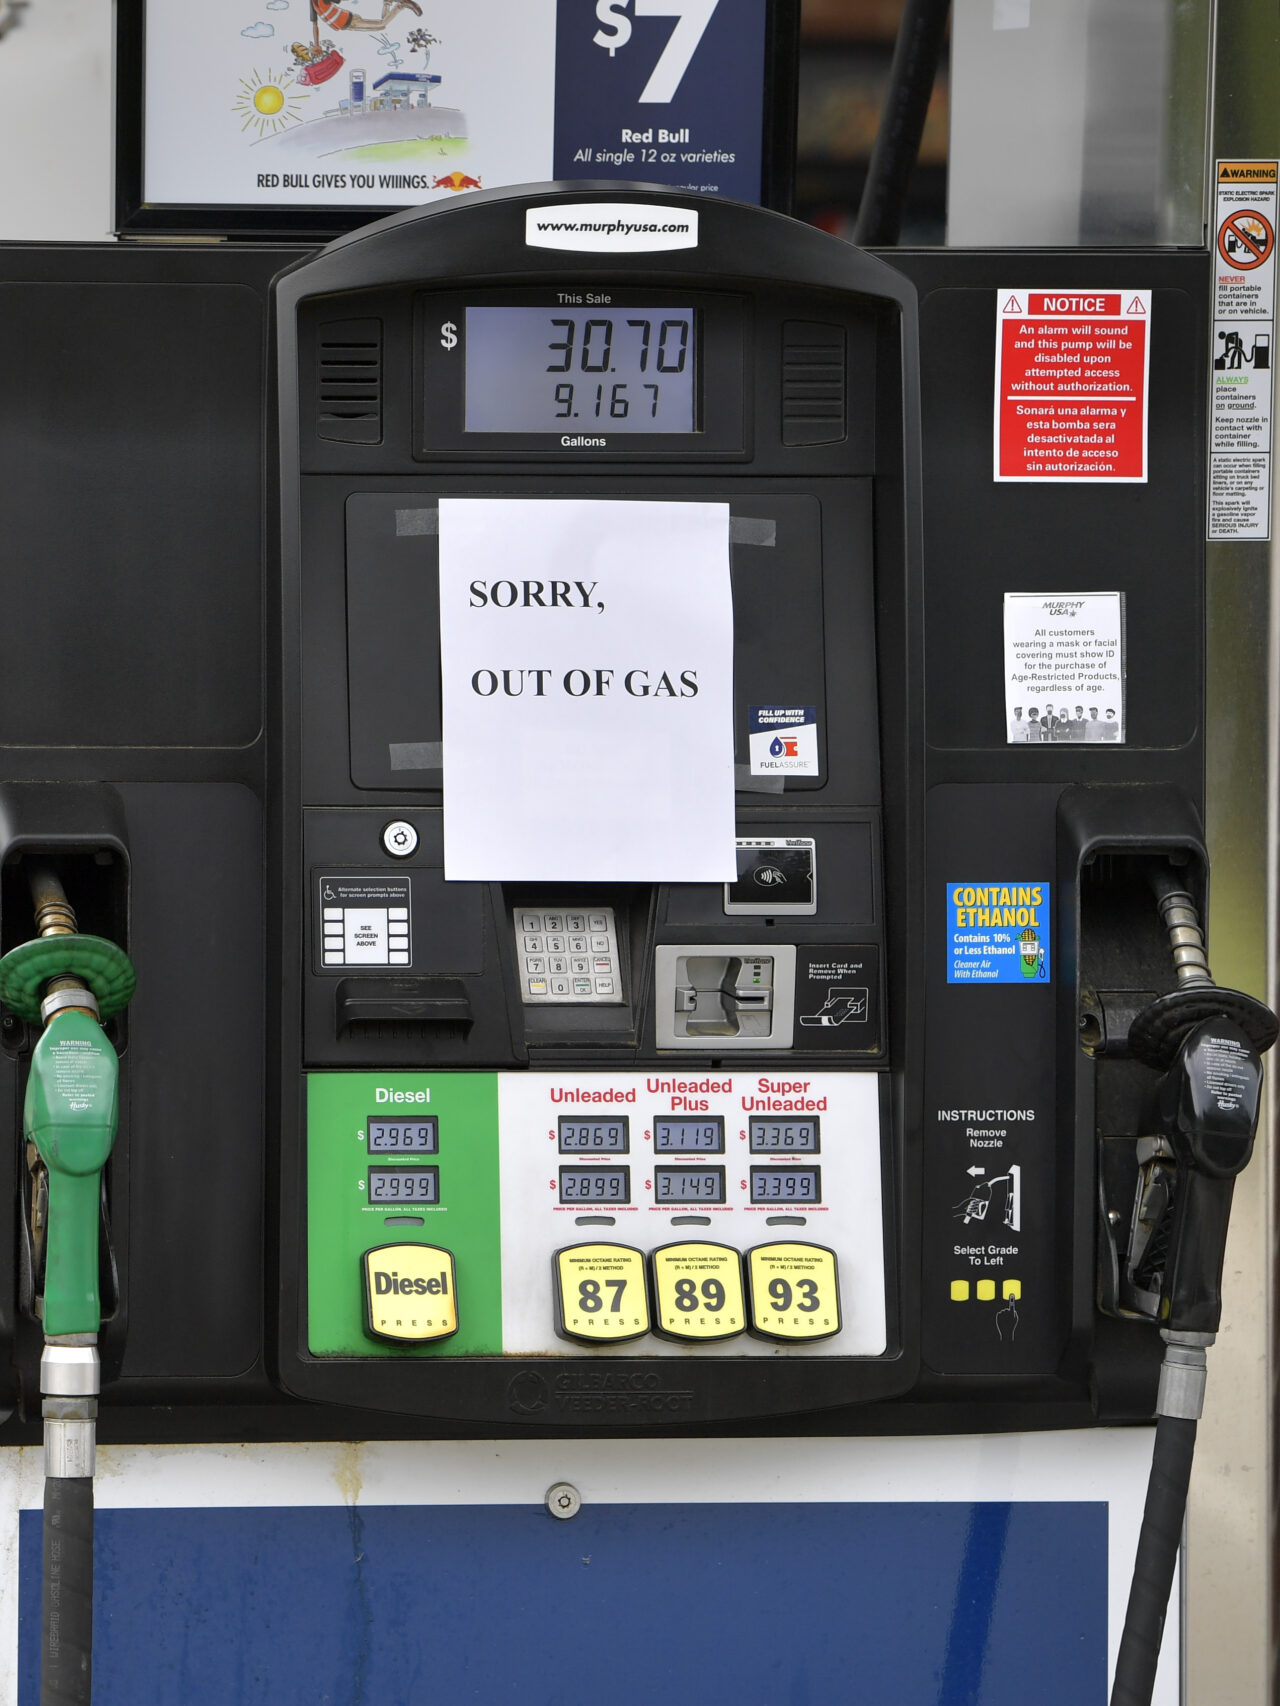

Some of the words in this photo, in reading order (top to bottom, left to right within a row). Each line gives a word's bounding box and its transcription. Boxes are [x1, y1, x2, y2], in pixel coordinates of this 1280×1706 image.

[622, 128, 652, 143] Red
[658, 128, 689, 143] Bull
[573, 147, 592, 161] All
[596, 148, 634, 165] single
[641, 148, 657, 162] 12
[660, 152, 676, 163] oz
[680, 149, 735, 162] varieties
[1230, 169, 1276, 179] WARNING
[257, 173, 279, 187] RED
[283, 173, 309, 188] BULL
[312, 173, 346, 188] GIVES
[349, 174, 374, 188] YOU
[537, 219, 689, 235] www.murphyusa.com
[1218, 275, 1245, 285] NEVER
[1218, 284, 1227, 292] fill
[1229, 285, 1261, 293] portable
[556, 293, 582, 304] This
[585, 293, 611, 304] Sale
[1218, 292, 1258, 300] containers
[1043, 297, 1104, 311] NOTICE
[1239, 307, 1268, 315] vehicle.
[1019, 324, 1034, 335] An
[1037, 324, 1068, 335] alarm
[1071, 325, 1091, 335] will
[1094, 325, 1128, 335] sound
[546, 319, 689, 373] 30.70
[1014, 338, 1034, 349] and
[1037, 338, 1058, 349] this
[1061, 341, 1092, 352] pump
[1095, 339, 1115, 349] will
[1118, 339, 1132, 350] be
[1034, 352, 1080, 363] disabled
[1083, 355, 1110, 365] upon
[1024, 367, 1081, 379] attempted
[1084, 369, 1120, 378] access
[1011, 380, 1054, 391] without
[1057, 381, 1132, 392] authorization.
[1215, 385, 1236, 394] place
[555, 383, 658, 418] 9.167
[1215, 393, 1256, 401] containers
[1015, 404, 1054, 415] Sonará
[1057, 407, 1078, 416] una
[1079, 405, 1117, 416] alarma
[1119, 408, 1126, 418] y
[1215, 403, 1225, 411] on
[1227, 401, 1256, 411] ground.
[1026, 420, 1049, 429] esta
[1051, 419, 1090, 430] bomba
[1092, 421, 1116, 430] sera
[560, 435, 606, 447] Gallons
[1026, 433, 1103, 444] desactivatada
[1105, 433, 1114, 444] al
[1023, 447, 1063, 457] intento
[1065, 447, 1079, 458] de
[1081, 449, 1118, 458] acceso
[1026, 461, 1042, 471] sin
[1044, 461, 1115, 472] autorización.
[470, 580, 604, 614] SORRY,
[1041, 601, 1085, 609] MURPHY
[1049, 608, 1068, 616] USA
[1034, 628, 1046, 637] All
[1048, 629, 1094, 637] customers
[1012, 639, 1046, 650] wearing
[1056, 639, 1079, 648] mask
[1094, 638, 1117, 647] facial
[1015, 651, 1052, 661] covering
[1055, 651, 1077, 659] must
[1079, 650, 1103, 659] show
[1105, 649, 1114, 658] ID
[1024, 661, 1036, 670] for
[1038, 661, 1052, 670] the
[1054, 661, 1095, 672] purchase
[1097, 660, 1106, 669] of
[472, 669, 551, 696] OUT
[564, 669, 613, 696] OF
[625, 669, 698, 697] GAS
[1011, 672, 1075, 683] Age-Restricted
[1077, 672, 1119, 681] Products,
[1026, 683, 1072, 694] regardless
[1074, 683, 1084, 692] of
[1086, 685, 1104, 694] age.
[758, 709, 773, 717] FILL
[773, 709, 784, 717] UP
[758, 716, 804, 724] CONFIDENCE
[953, 887, 1042, 906] CONTAINS
[957, 908, 1039, 926] ETHANOL
[953, 932, 990, 943] Contains
[992, 933, 1010, 943] 10%
[953, 947, 963, 955] or
[964, 945, 981, 955] Less
[982, 944, 1015, 955] Ethanol
[953, 959, 980, 969] Cleaner
[981, 960, 991, 969] Air
[954, 969, 970, 979] With
[971, 969, 998, 979] Ethanol
[646, 1078, 732, 1092] Unleaded
[758, 1077, 810, 1097] Super
[376, 1087, 430, 1102] Diesel
[551, 1087, 635, 1102] Unleaded
[671, 1096, 710, 1111] Plus
[742, 1095, 826, 1111] Unleaded
[937, 1109, 1034, 1122] INSTRUCTIONS
[374, 1127, 428, 1146] 2.969
[564, 1127, 618, 1146] 2.869
[661, 1127, 713, 1146] 3.119
[757, 1127, 809, 1145] 3.369
[966, 1127, 1006, 1137] Remove
[969, 1138, 1002, 1148] Nozzle
[375, 1177, 429, 1196] 2.999
[566, 1177, 619, 1196] 2.899
[662, 1176, 714, 1195] 3.149
[758, 1177, 810, 1196] 3.399
[953, 1245, 984, 1255] Select
[987, 1245, 1018, 1255] Grade
[968, 1255, 981, 1266] To
[983, 1256, 1003, 1266] Left
[374, 1271, 448, 1295] Diesel
[579, 1279, 627, 1313] 87
[675, 1277, 725, 1312] 89
[768, 1277, 820, 1312] 93
